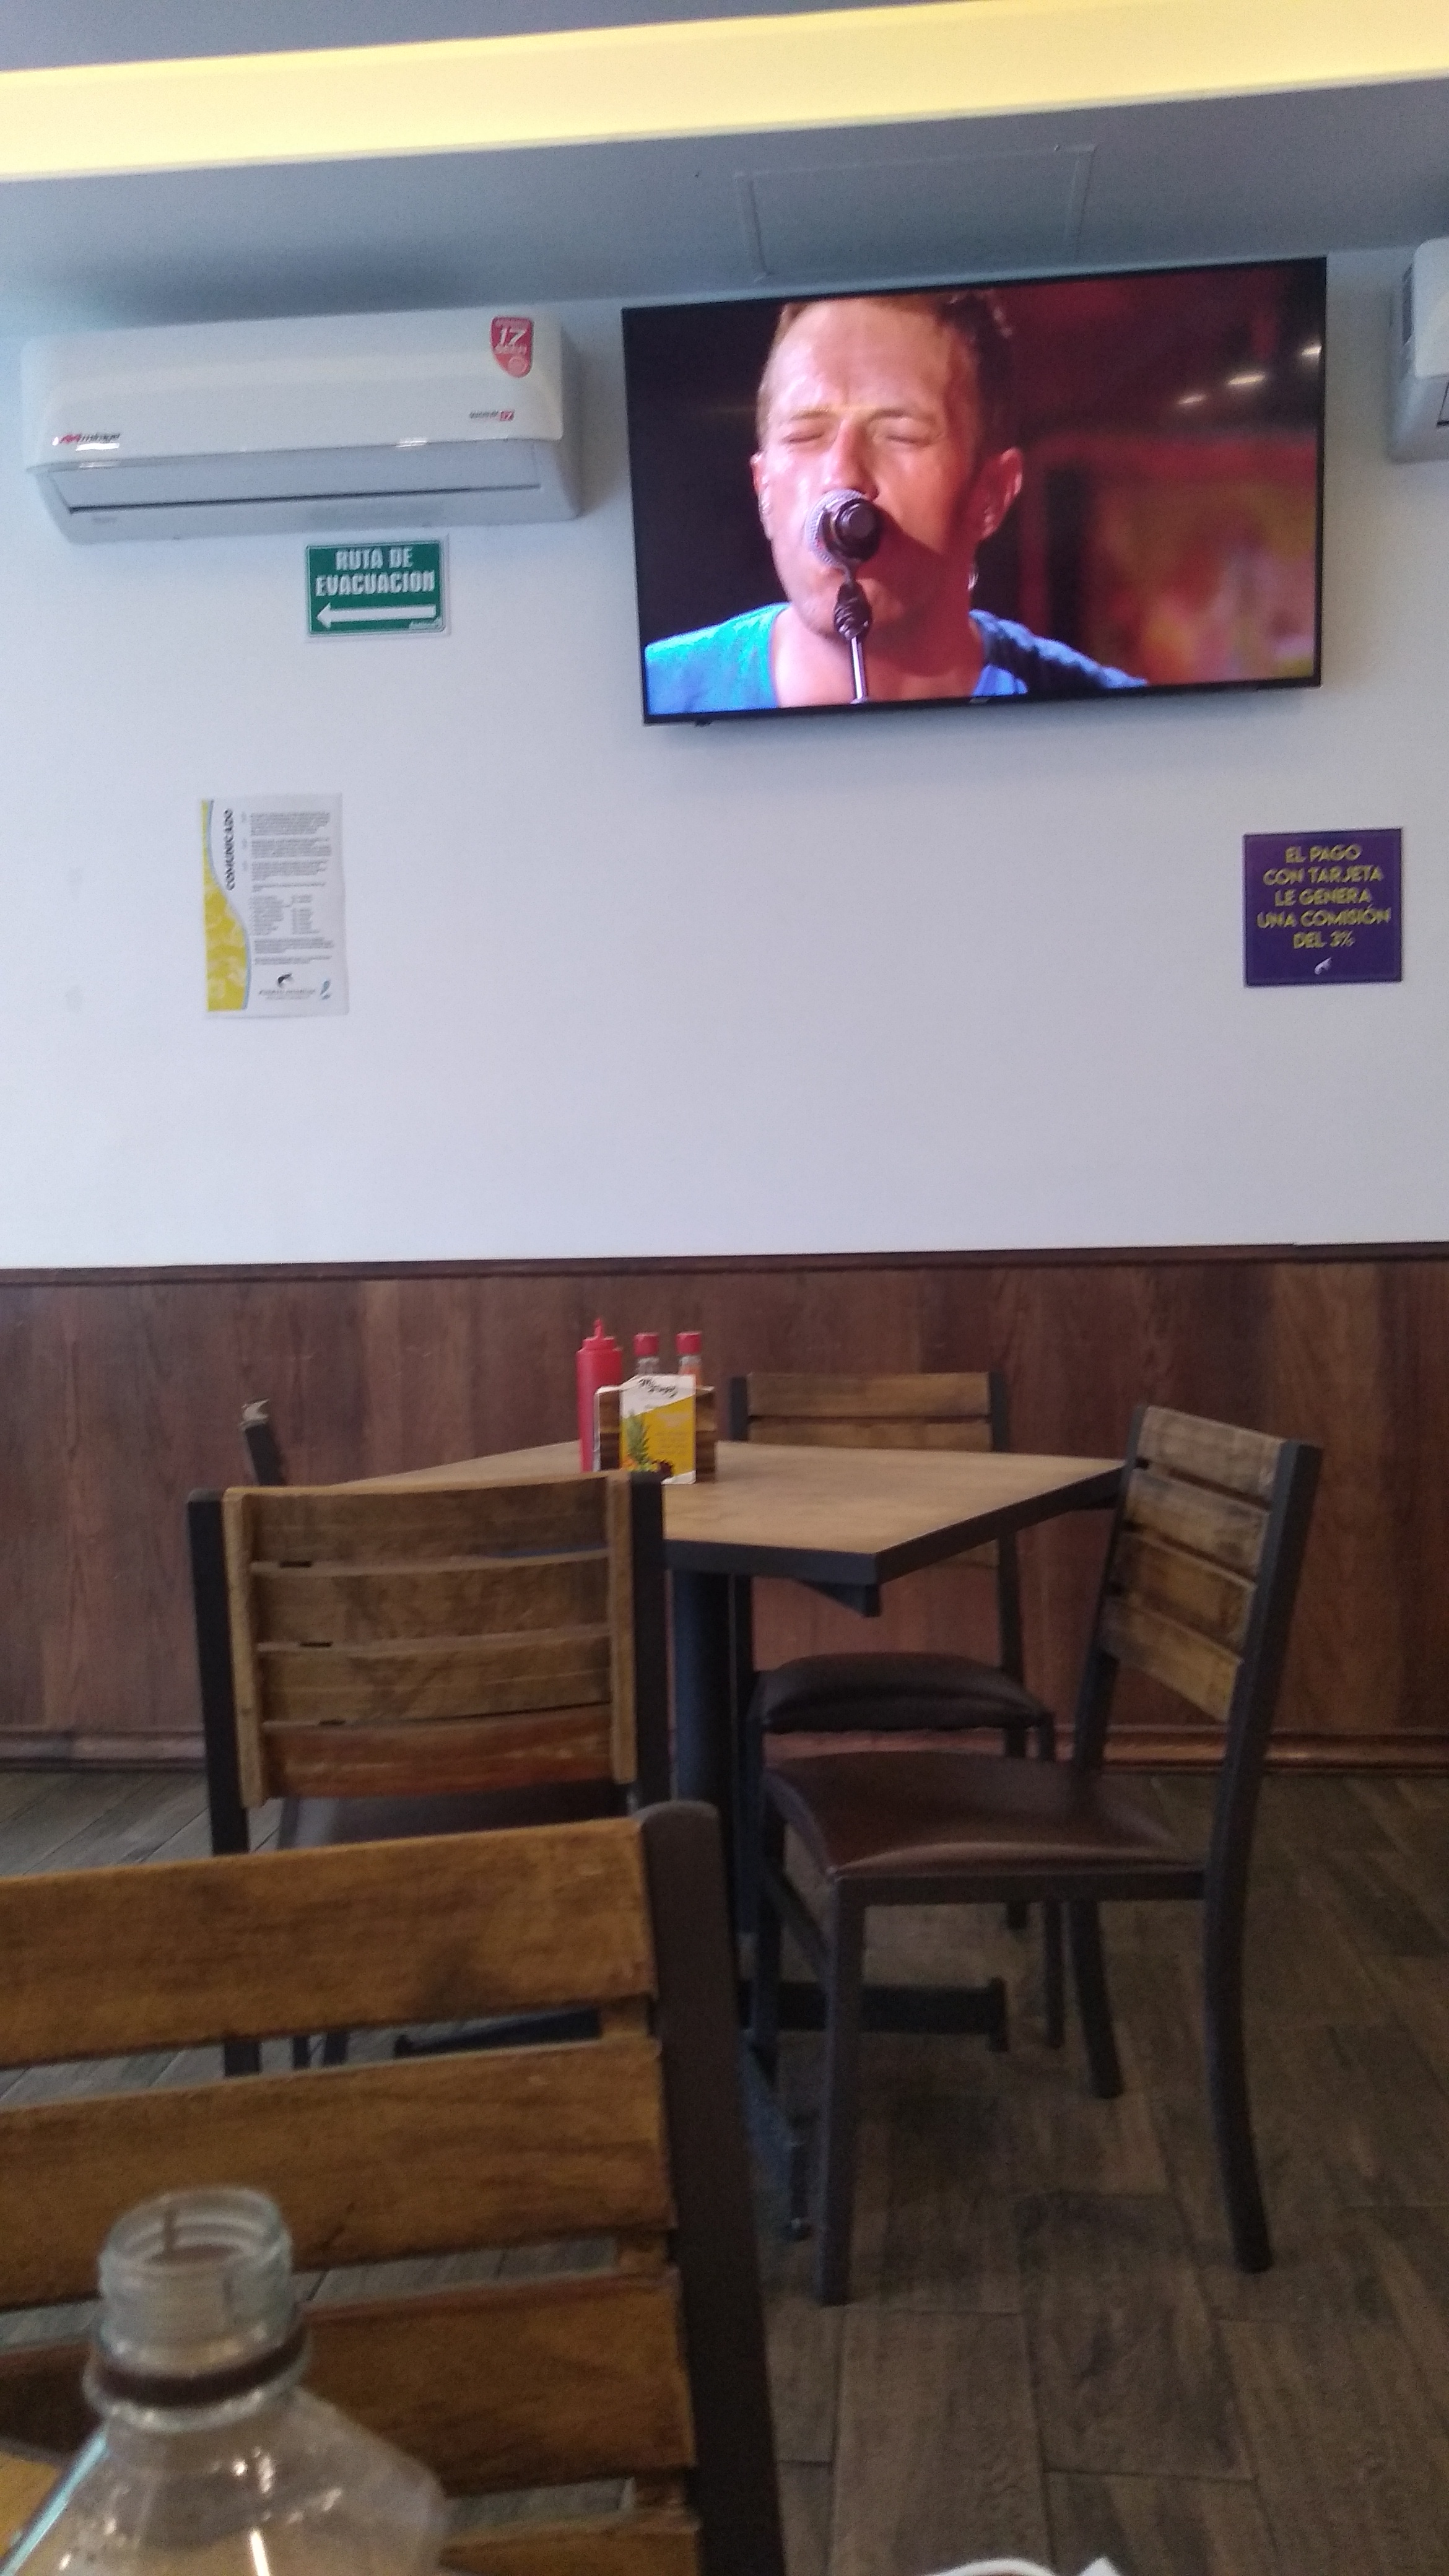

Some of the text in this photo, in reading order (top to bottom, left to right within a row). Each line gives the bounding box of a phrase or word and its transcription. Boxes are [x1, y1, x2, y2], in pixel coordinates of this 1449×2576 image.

[499, 328, 527, 346] 17
[335, 546, 414, 571] RUTA DE
[315, 570, 435, 596] EVACUACION
[224, 808, 235, 891] COMUNICADO
[1285, 843, 1362, 863] EL PAGO
[1263, 865, 1384, 886] CON TARJETA
[1274, 887, 1373, 907] LE GENERA
[1256, 905, 1392, 928] UNA COMISIÓN
[1292, 930, 1356, 949] DEL 3%
